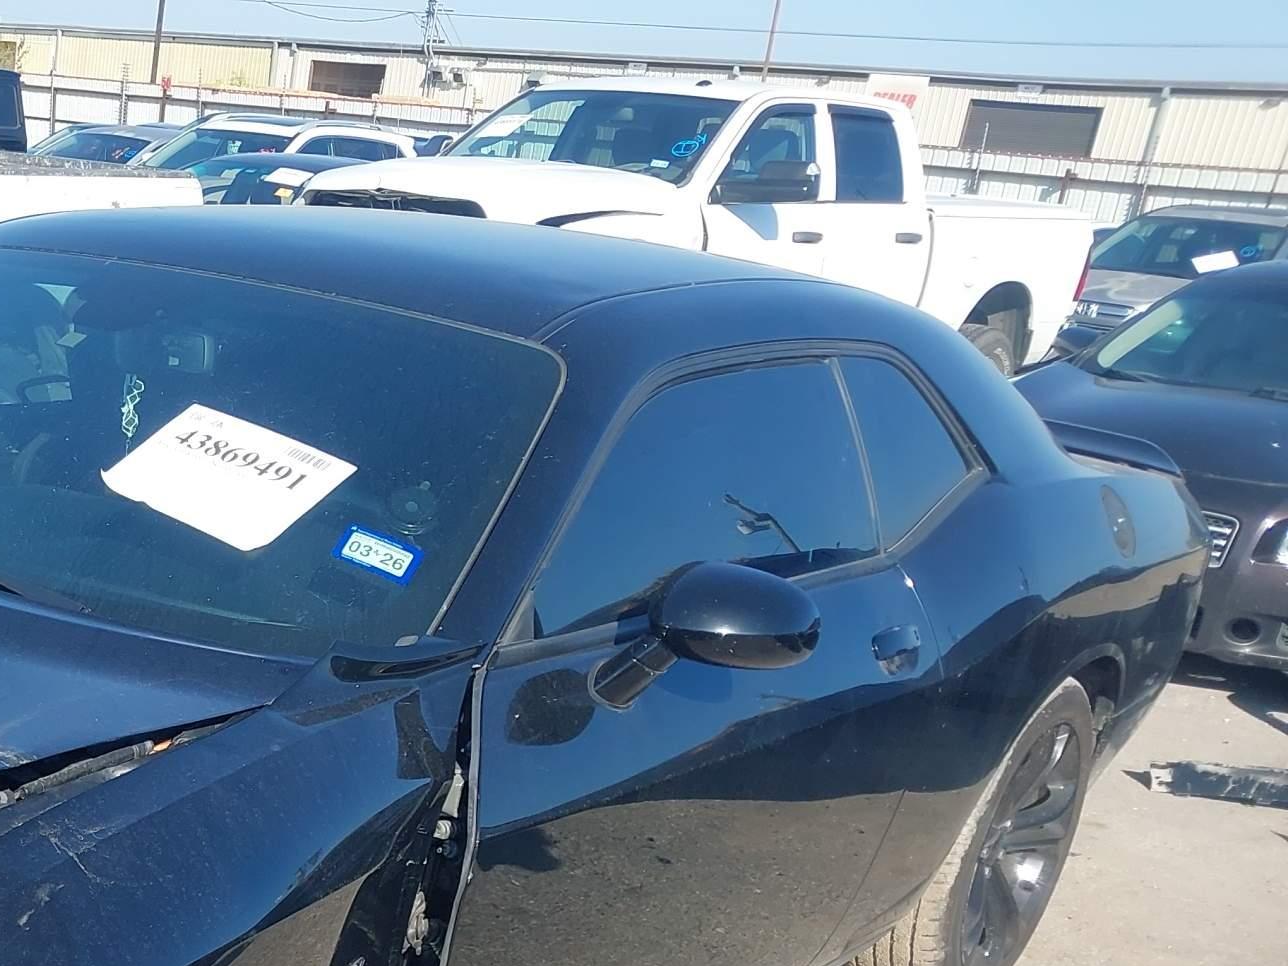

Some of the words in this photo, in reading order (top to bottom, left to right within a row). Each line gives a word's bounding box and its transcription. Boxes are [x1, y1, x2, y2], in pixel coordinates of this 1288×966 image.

[174, 430, 308, 491] 43869491
[348, 540, 373, 557] 03
[379, 552, 406, 571] 26
